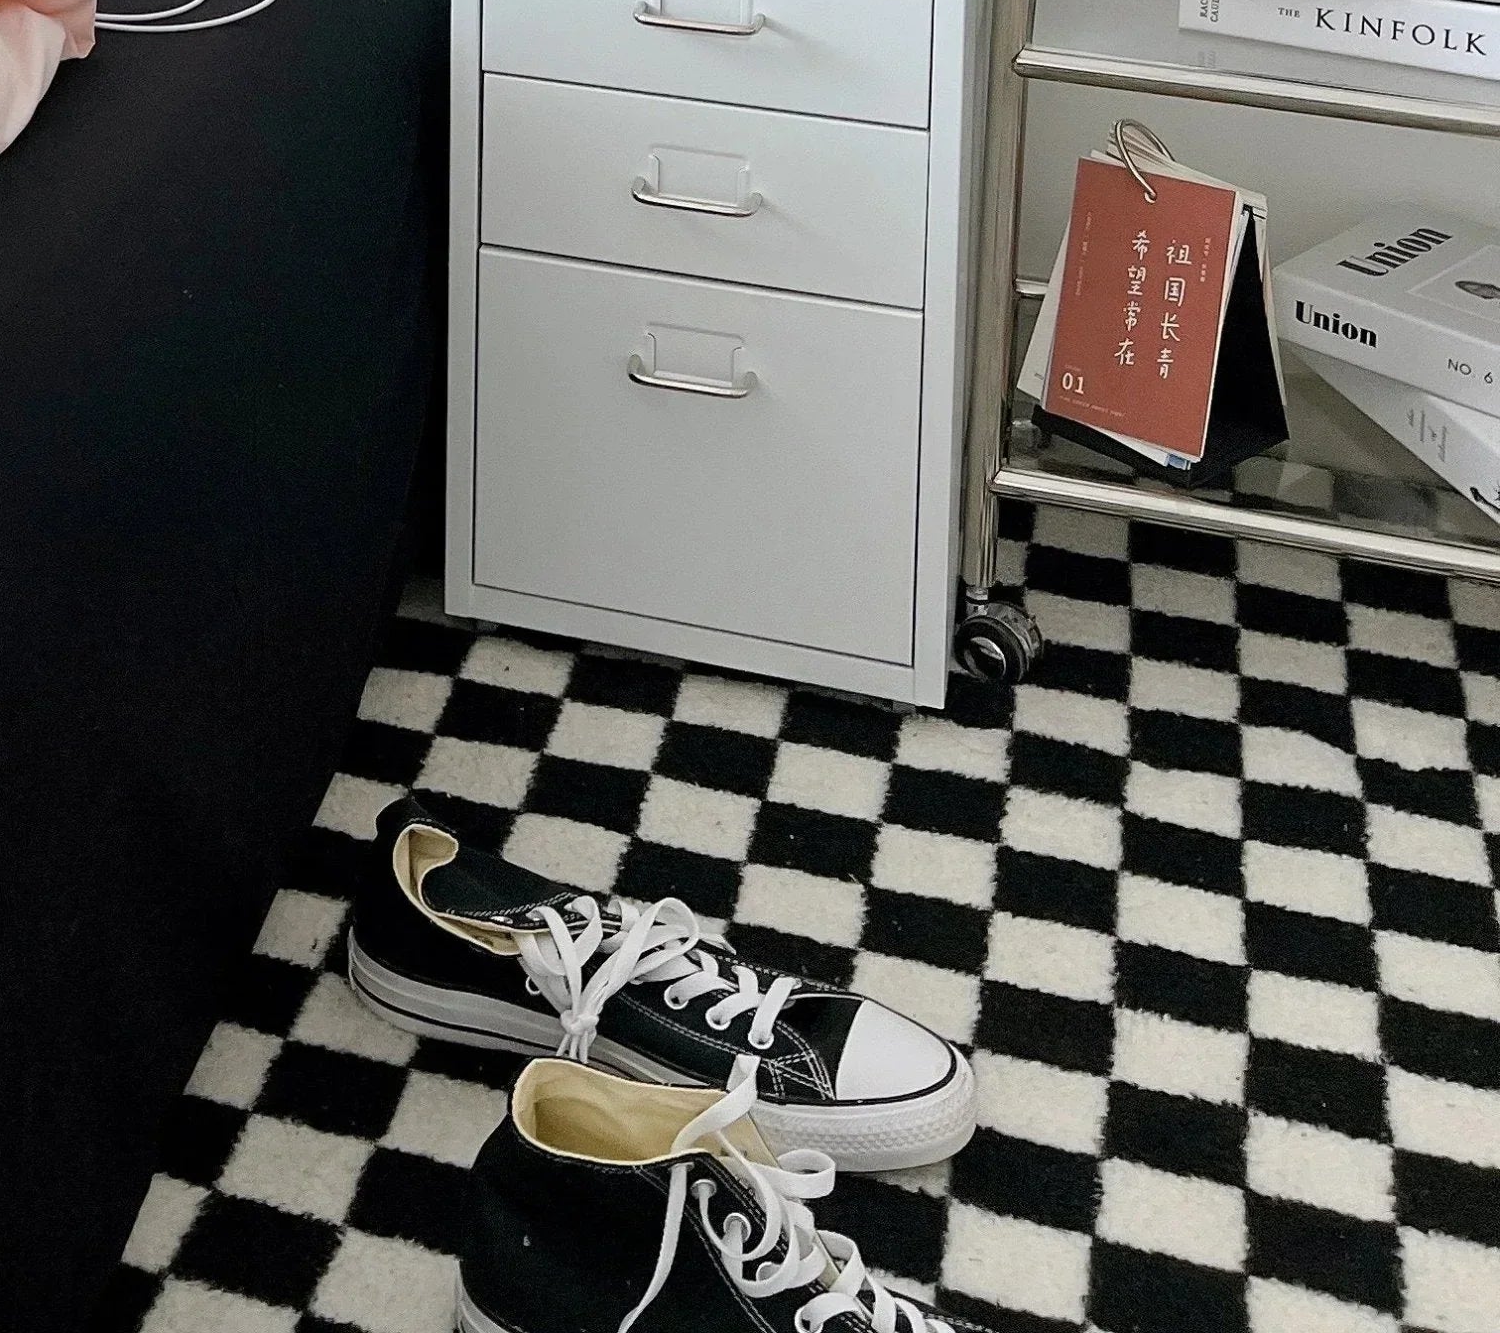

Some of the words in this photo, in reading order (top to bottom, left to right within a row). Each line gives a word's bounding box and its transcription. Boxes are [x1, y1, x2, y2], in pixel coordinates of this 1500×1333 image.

[1277, 7, 1301, 18] THE
[1314, 7, 1487, 56] KINFOLK
[1336, 228, 1453, 276] Union
[1113, 230, 1151, 367] 希望常在
[1156, 239, 1193, 379] 祖国长青
[1296, 300, 1377, 348] Union
[1484, 371, 1493, 384] 6
[1061, 372, 1085, 395] 01
